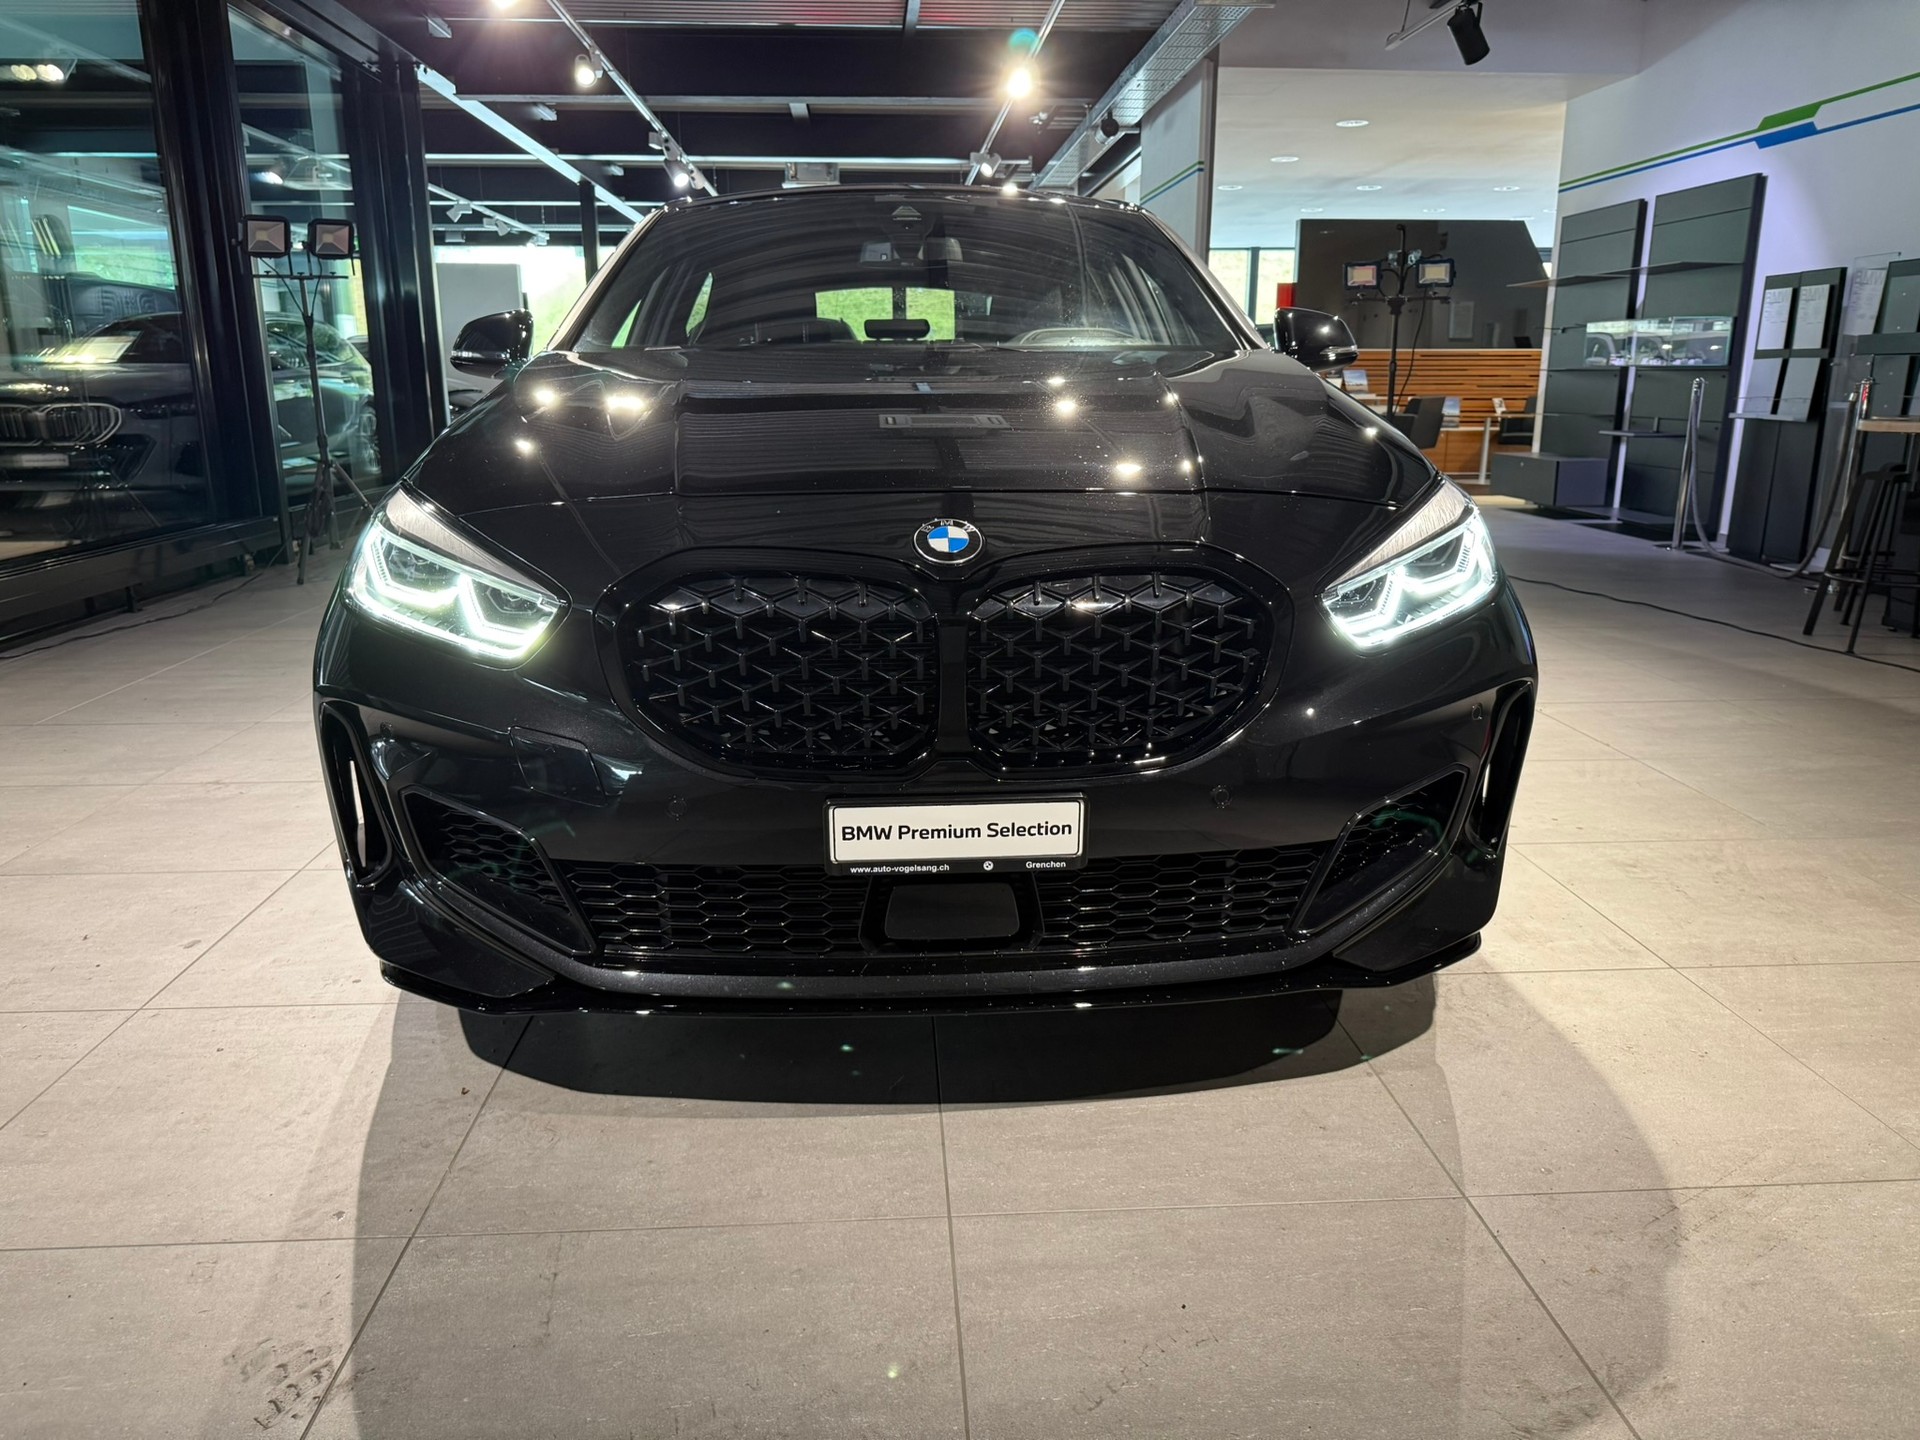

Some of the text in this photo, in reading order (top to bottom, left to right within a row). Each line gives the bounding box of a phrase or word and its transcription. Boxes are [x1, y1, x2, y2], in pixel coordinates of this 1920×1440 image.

[842, 821, 1072, 840] BMW Premium Selection
[849, 863, 950, 874] www.auto-vogelsang.ch
